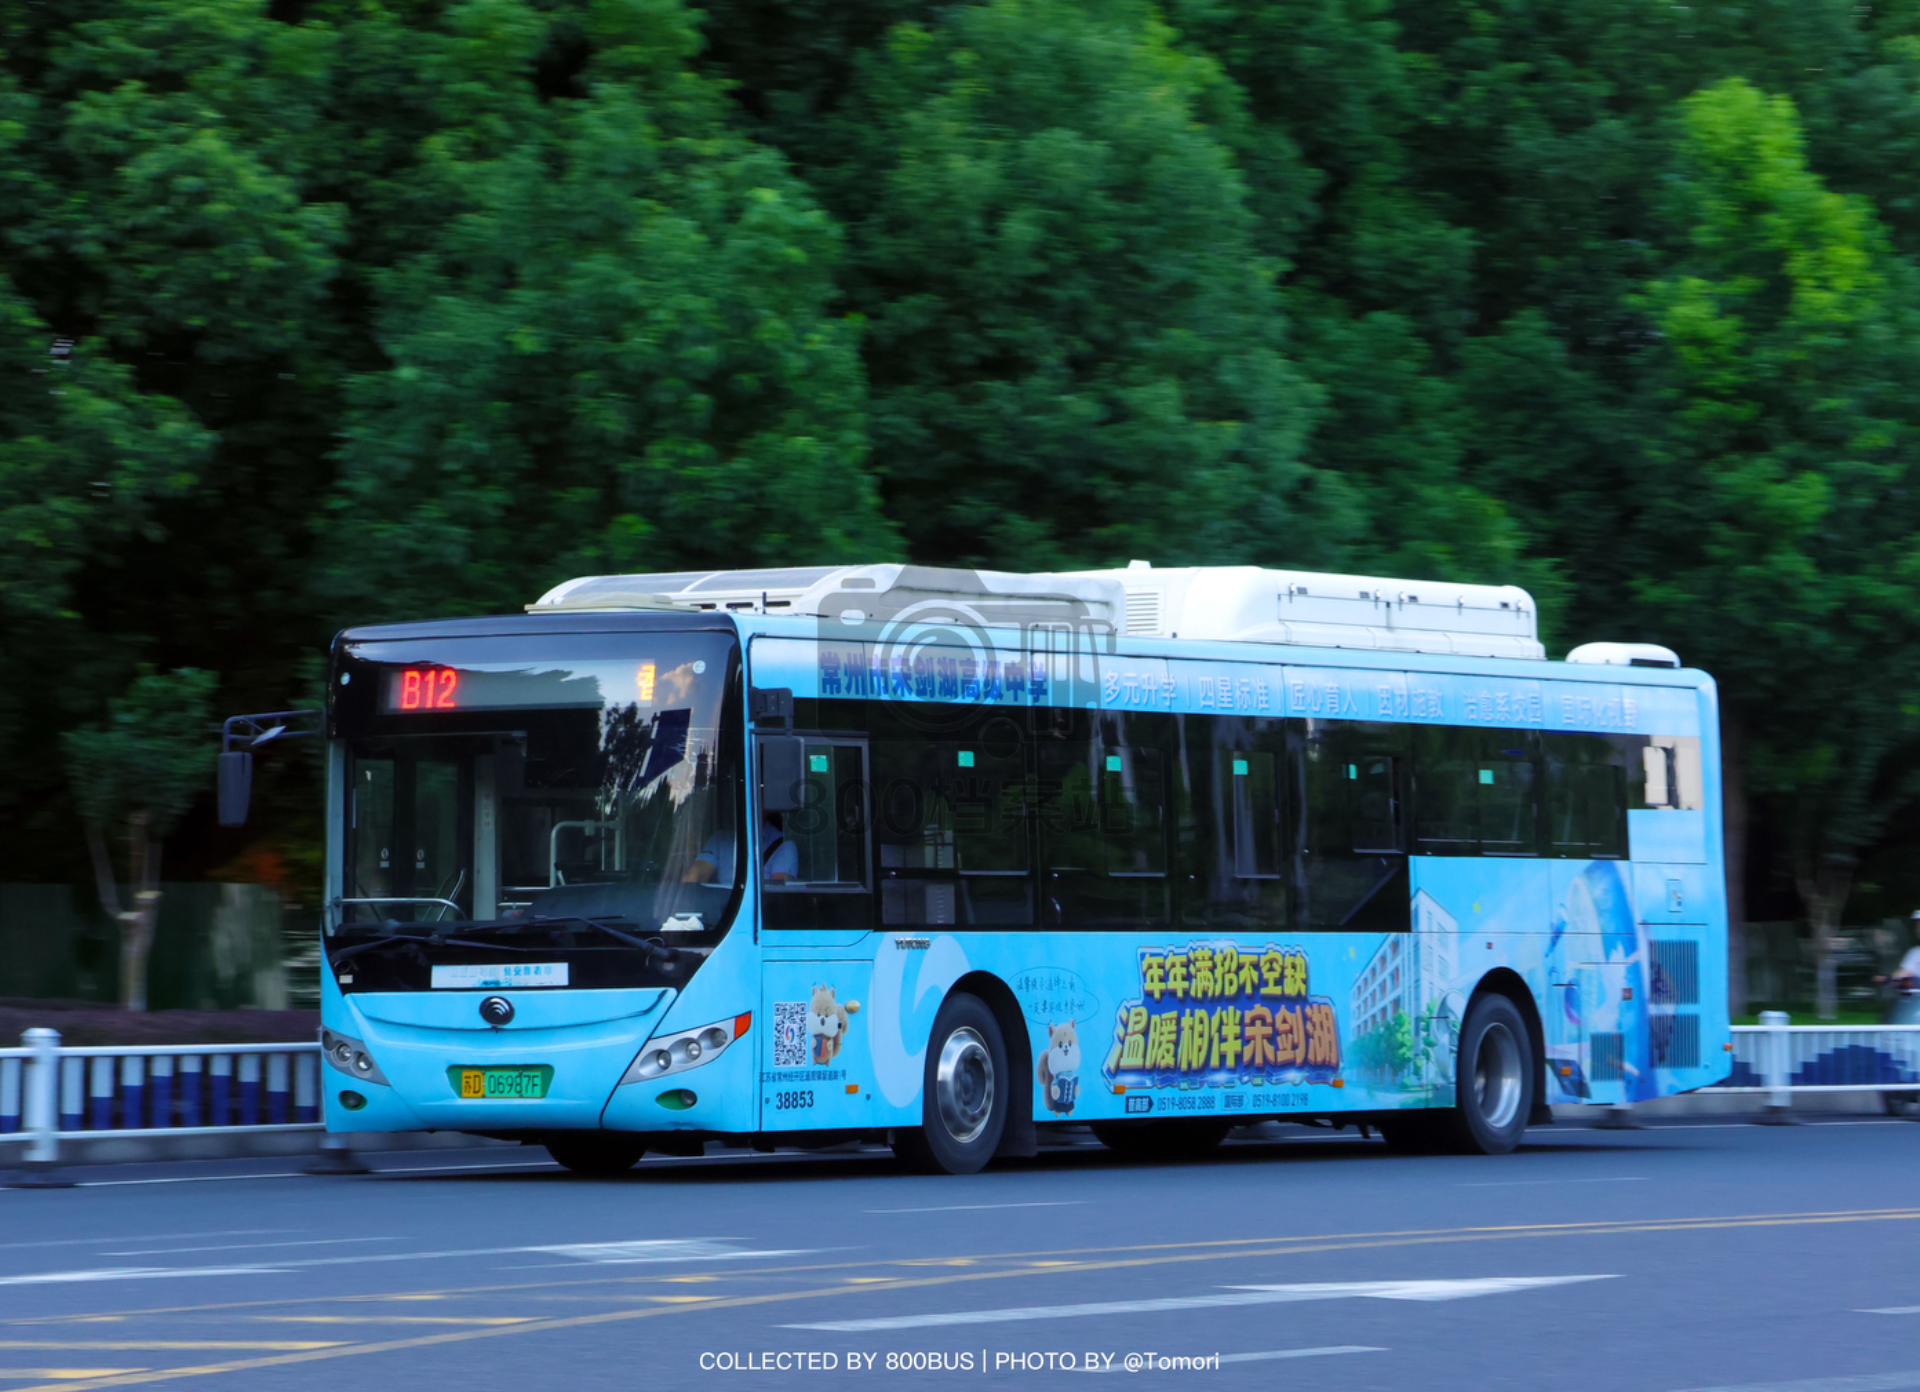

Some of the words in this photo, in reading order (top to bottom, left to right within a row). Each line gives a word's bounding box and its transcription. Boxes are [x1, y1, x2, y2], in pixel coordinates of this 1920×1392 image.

[402, 670, 457, 709] B12
[820, 650, 1048, 703] 常州市宋剑湖高级中学
[1104, 670, 1177, 707] 多元升学
[1199, 676, 1269, 711] 四星标准
[1289, 679, 1358, 715] 匠心育人
[1142, 947, 1308, 1000] 年年满招不空缺
[1107, 1004, 1340, 1072] 温暖相伴宋剑湖
[488, 1074, 540, 1094] 06987F
[776, 1090, 814, 1110] 38853
